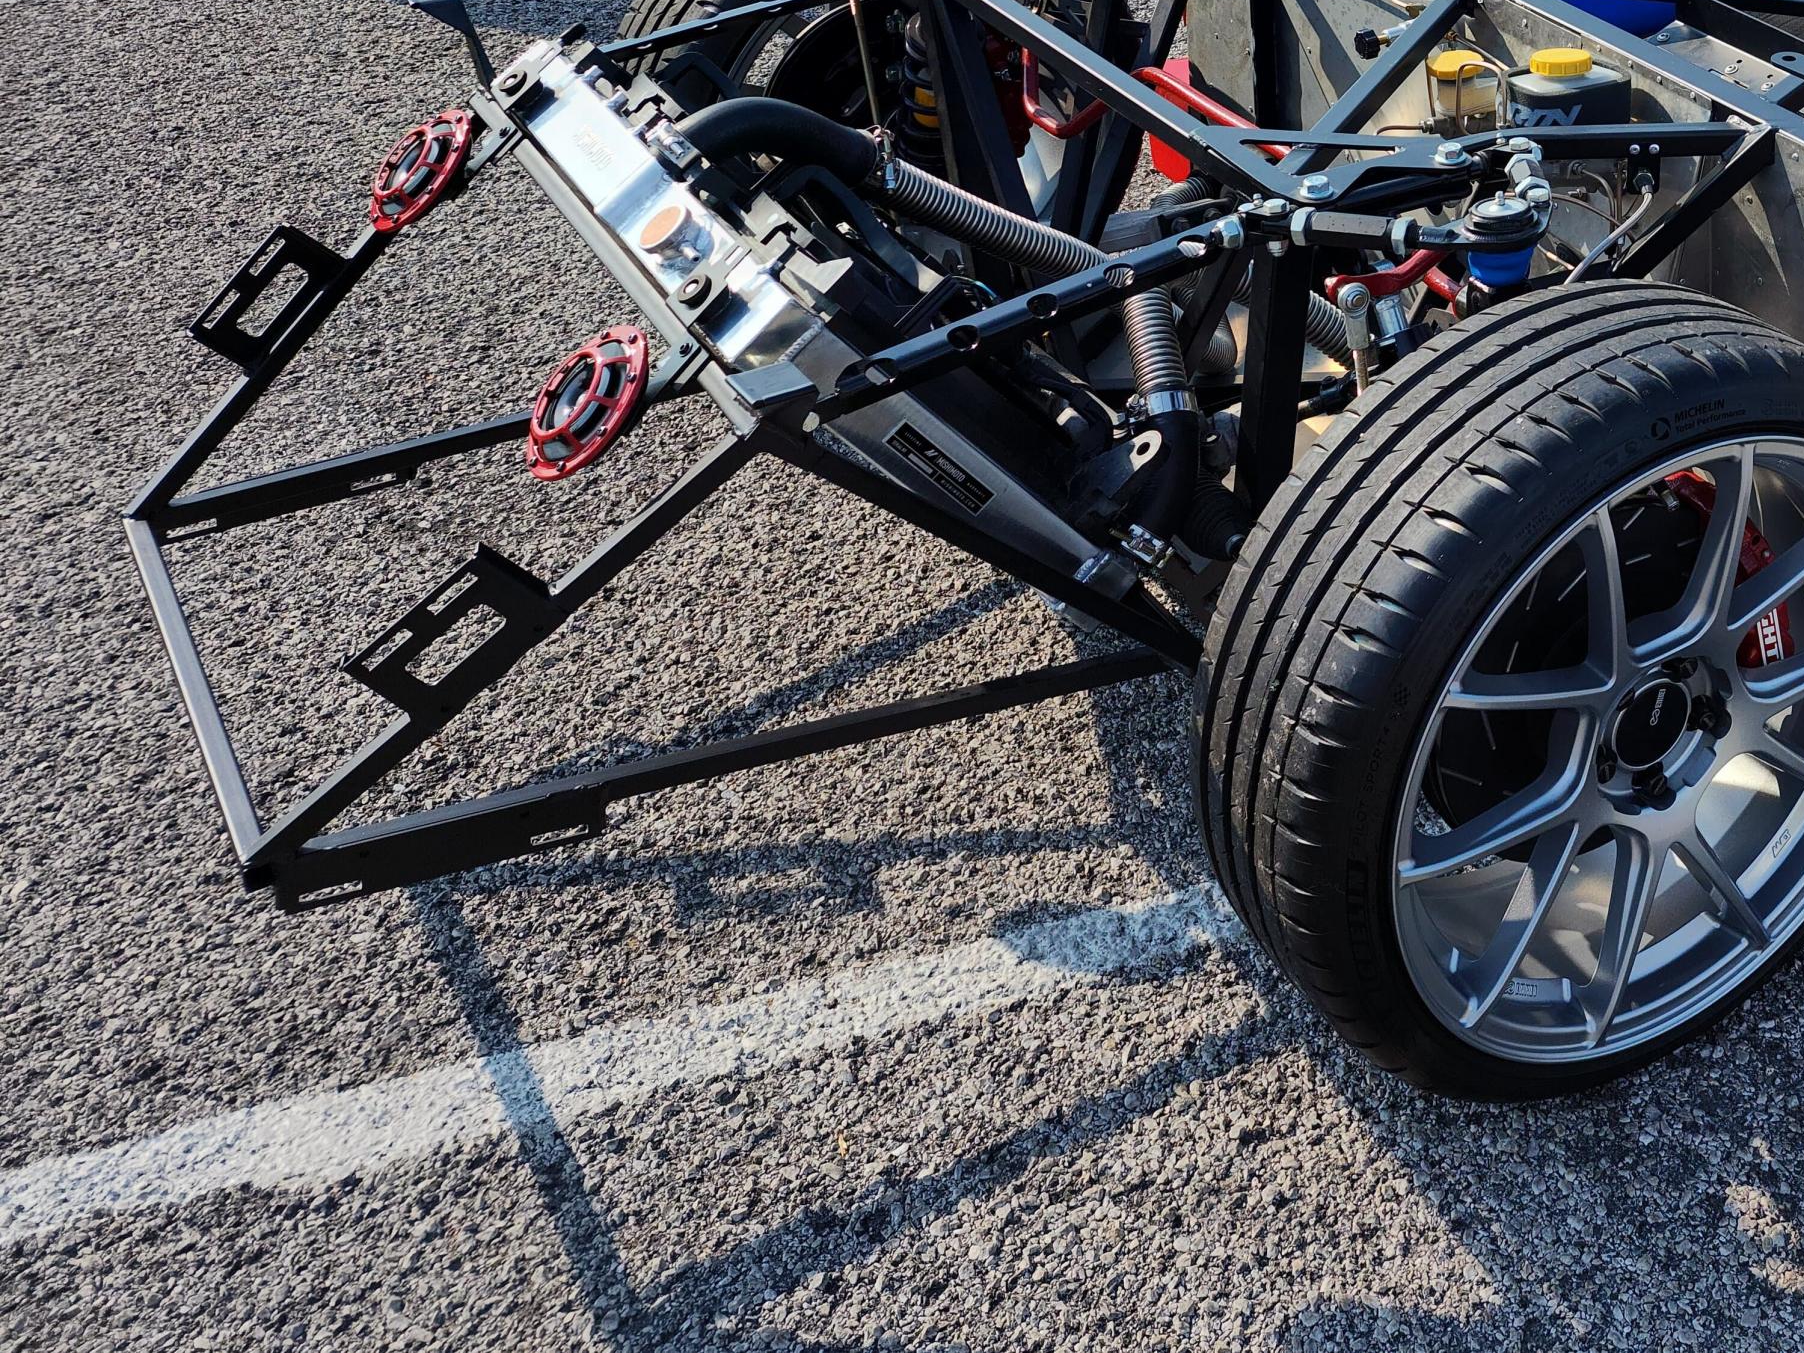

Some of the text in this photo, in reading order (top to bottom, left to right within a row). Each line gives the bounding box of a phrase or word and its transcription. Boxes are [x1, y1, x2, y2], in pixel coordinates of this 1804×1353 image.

[1674, 398, 1726, 423] MICHELIN
[1696, 407, 1747, 428] Performance
[936, 456, 966, 483] MISHIMOTO
